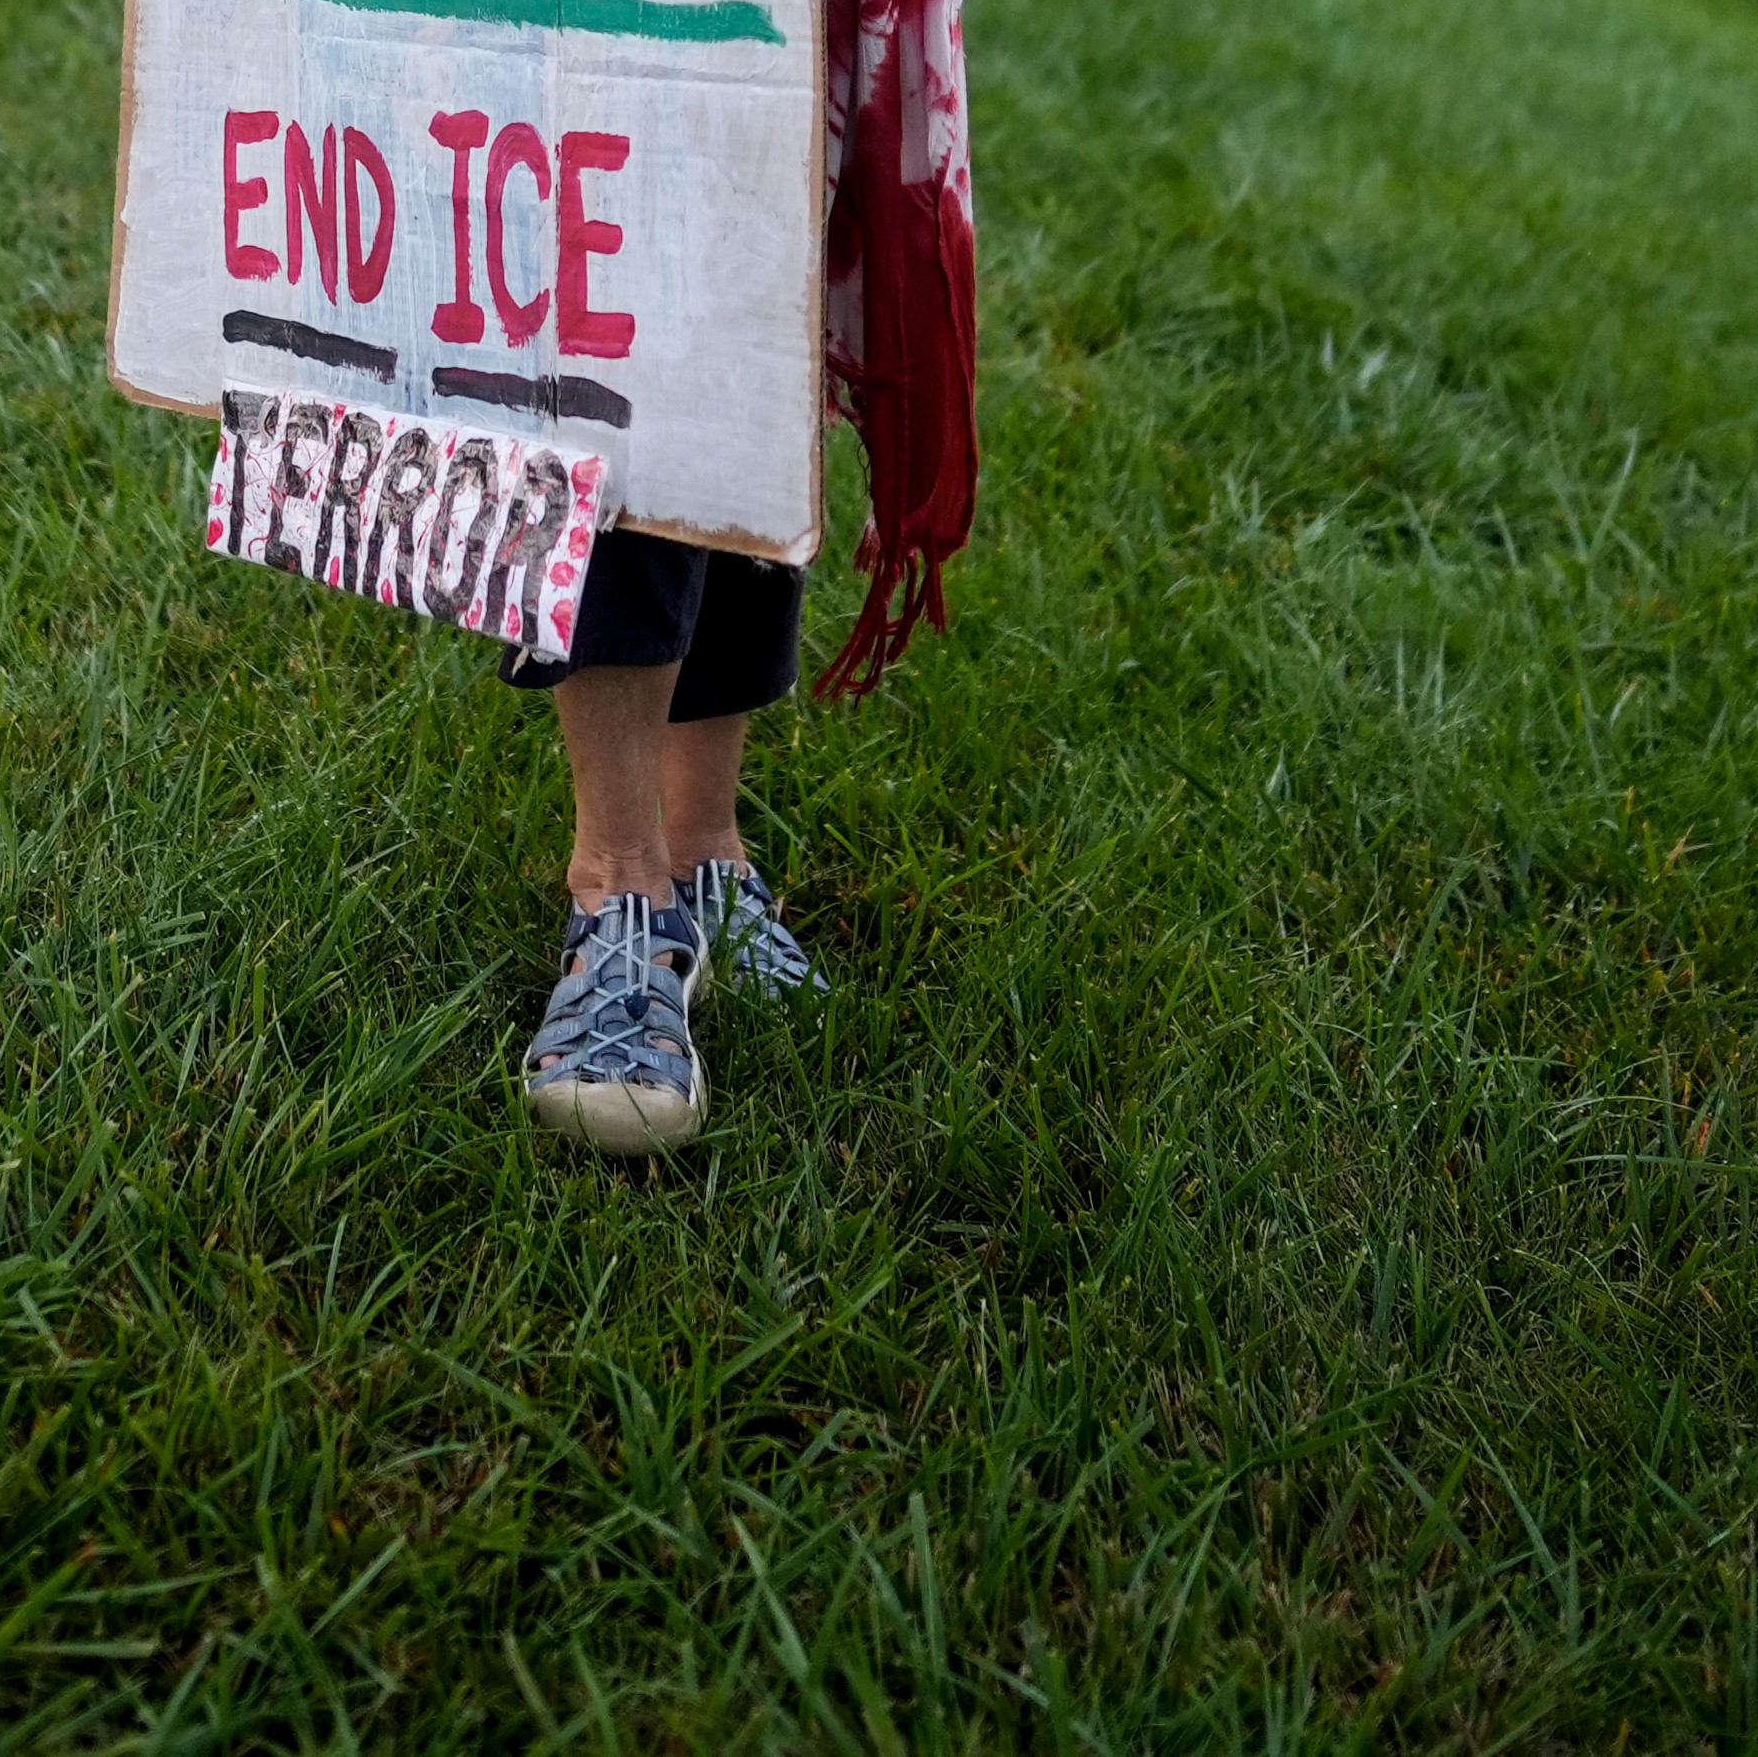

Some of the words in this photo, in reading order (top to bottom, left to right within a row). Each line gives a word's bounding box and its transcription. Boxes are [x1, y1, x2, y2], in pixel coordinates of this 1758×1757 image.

[224, 109, 395, 306] END
[429, 110, 636, 359] ICE
[222, 389, 569, 644] TERROR
